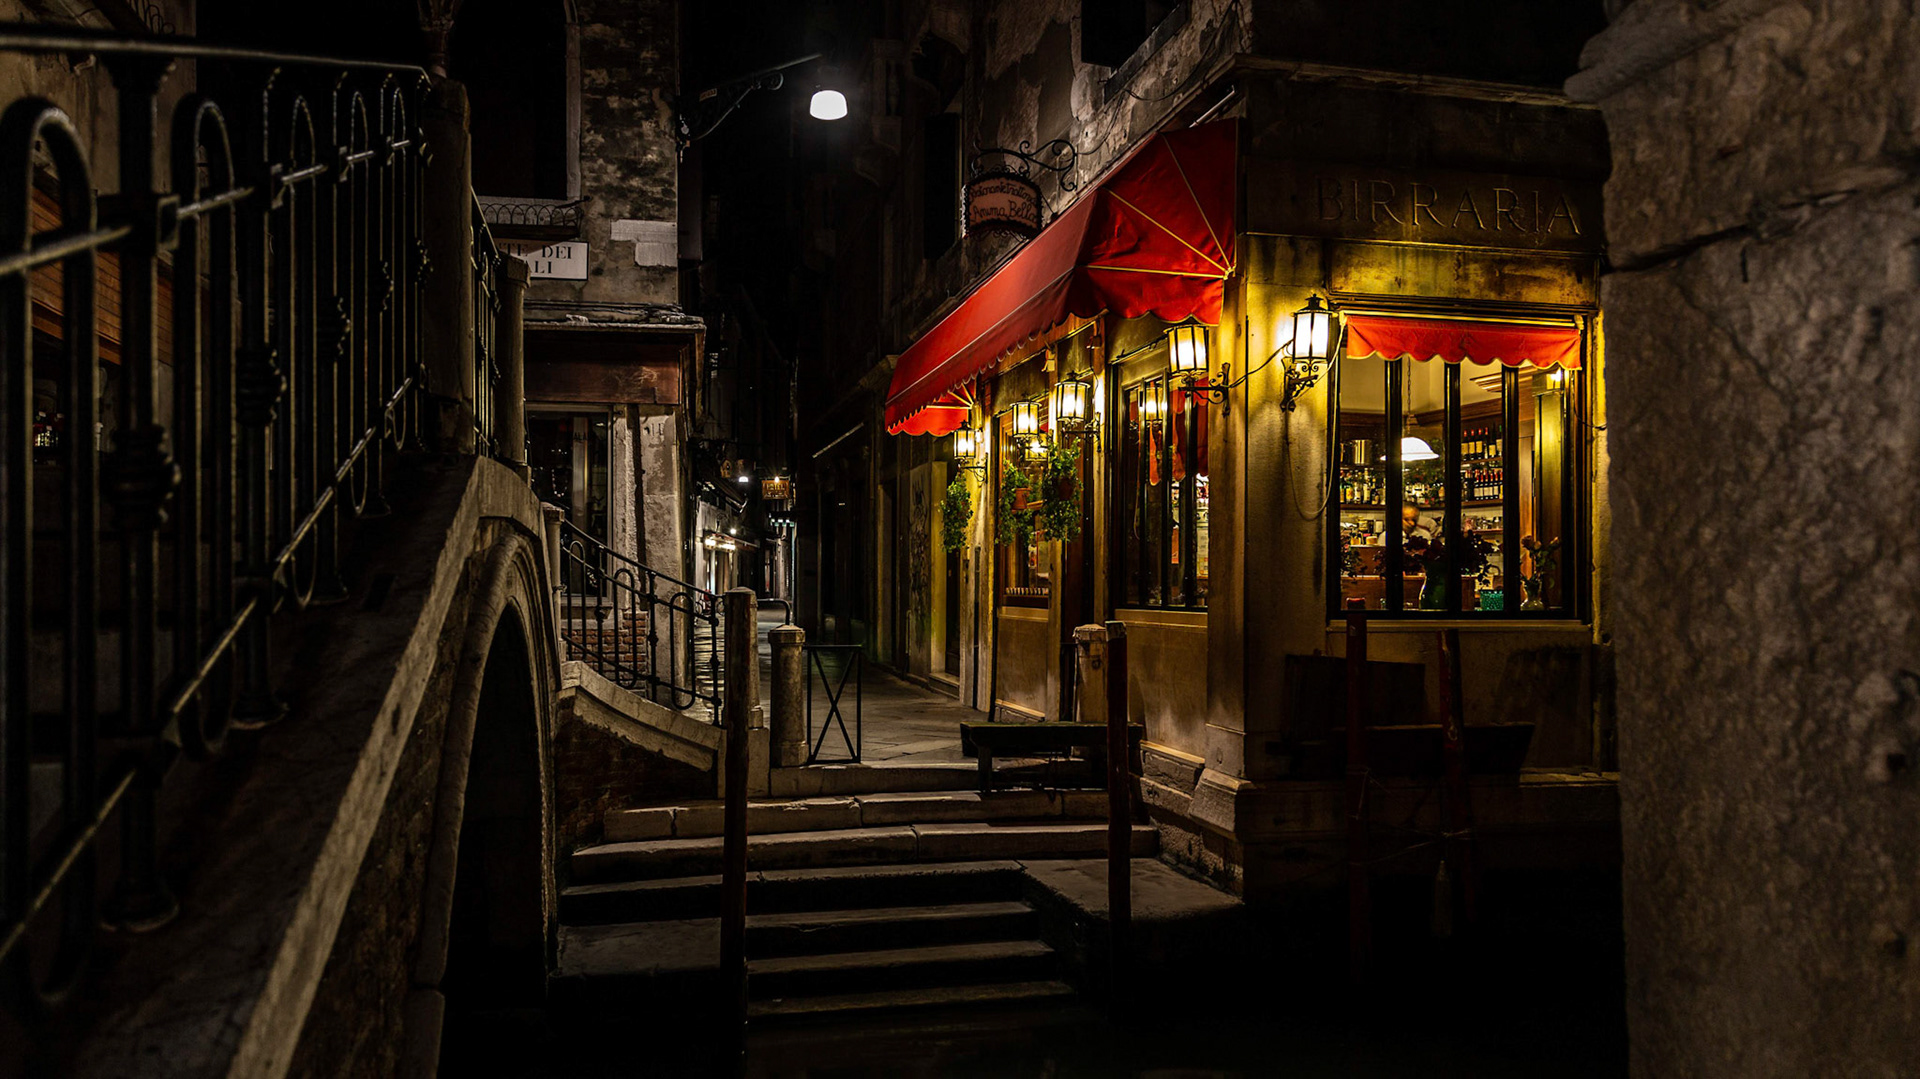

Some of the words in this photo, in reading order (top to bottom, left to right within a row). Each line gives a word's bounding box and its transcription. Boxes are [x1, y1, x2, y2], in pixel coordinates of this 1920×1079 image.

[1006, 200, 1037, 223] Bella
[1316, 177, 1583, 235] BIRRARIA
[542, 245, 572, 259] DEI
[534, 260, 552, 274] LI
